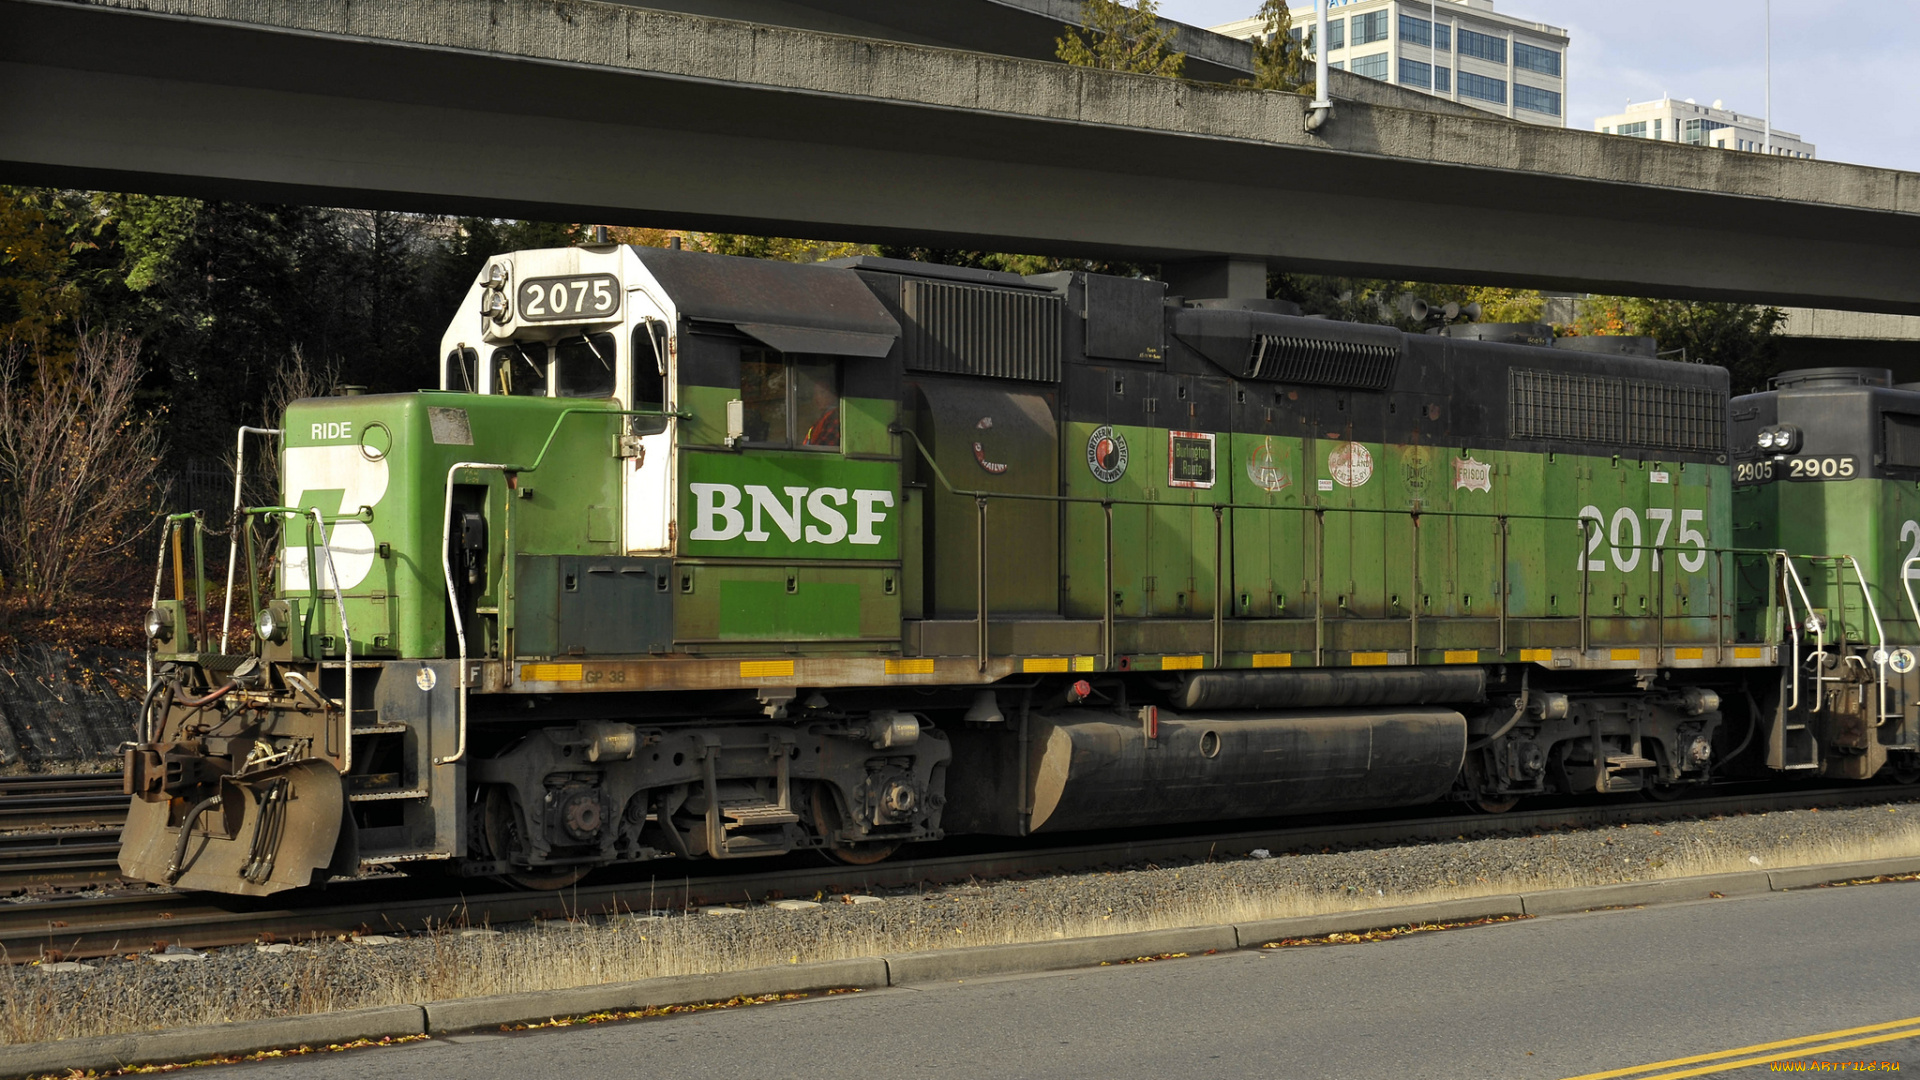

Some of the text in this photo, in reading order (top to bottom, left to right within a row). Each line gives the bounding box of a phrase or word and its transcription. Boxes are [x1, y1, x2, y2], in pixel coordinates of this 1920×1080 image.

[526, 279, 613, 316] 2075
[311, 422, 352, 440] RIDE
[1089, 427, 1112, 463] NORTHERN
[1176, 443, 1209, 461] Burlington
[1094, 464, 1122, 481] RAILWAY
[1182, 460, 1203, 476] Route
[1460, 468, 1485, 481] FRISCO
[1737, 461, 1773, 482] 2905
[1790, 457, 1854, 478] 2905
[689, 482, 895, 545] BNSF
[1576, 504, 1706, 573] 2075
[470, 666, 481, 682] F
[585, 670, 625, 683] GP 38
